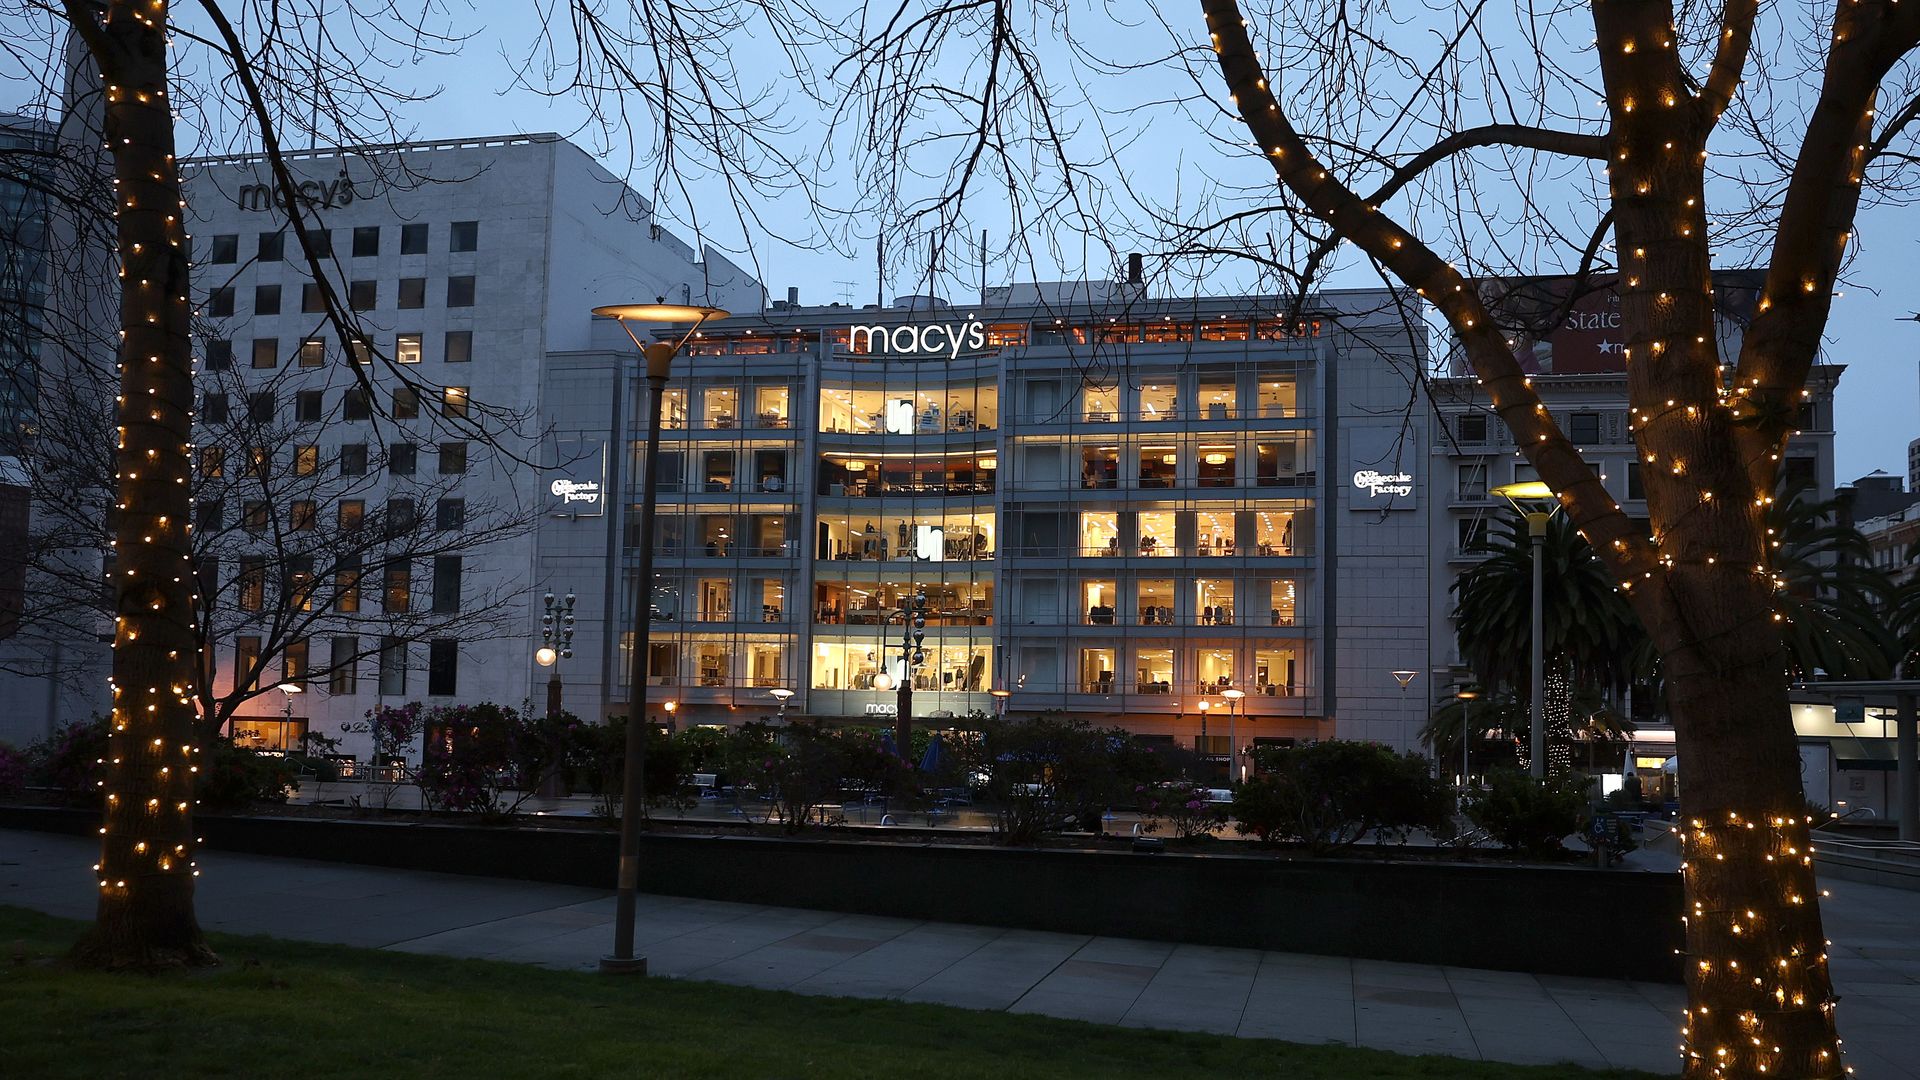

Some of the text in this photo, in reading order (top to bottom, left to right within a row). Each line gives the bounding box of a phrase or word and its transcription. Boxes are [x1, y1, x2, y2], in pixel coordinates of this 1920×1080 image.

[849, 312, 984, 359] macy's
[1371, 484, 1412, 497] Factory
[866, 703, 897, 713] mac
